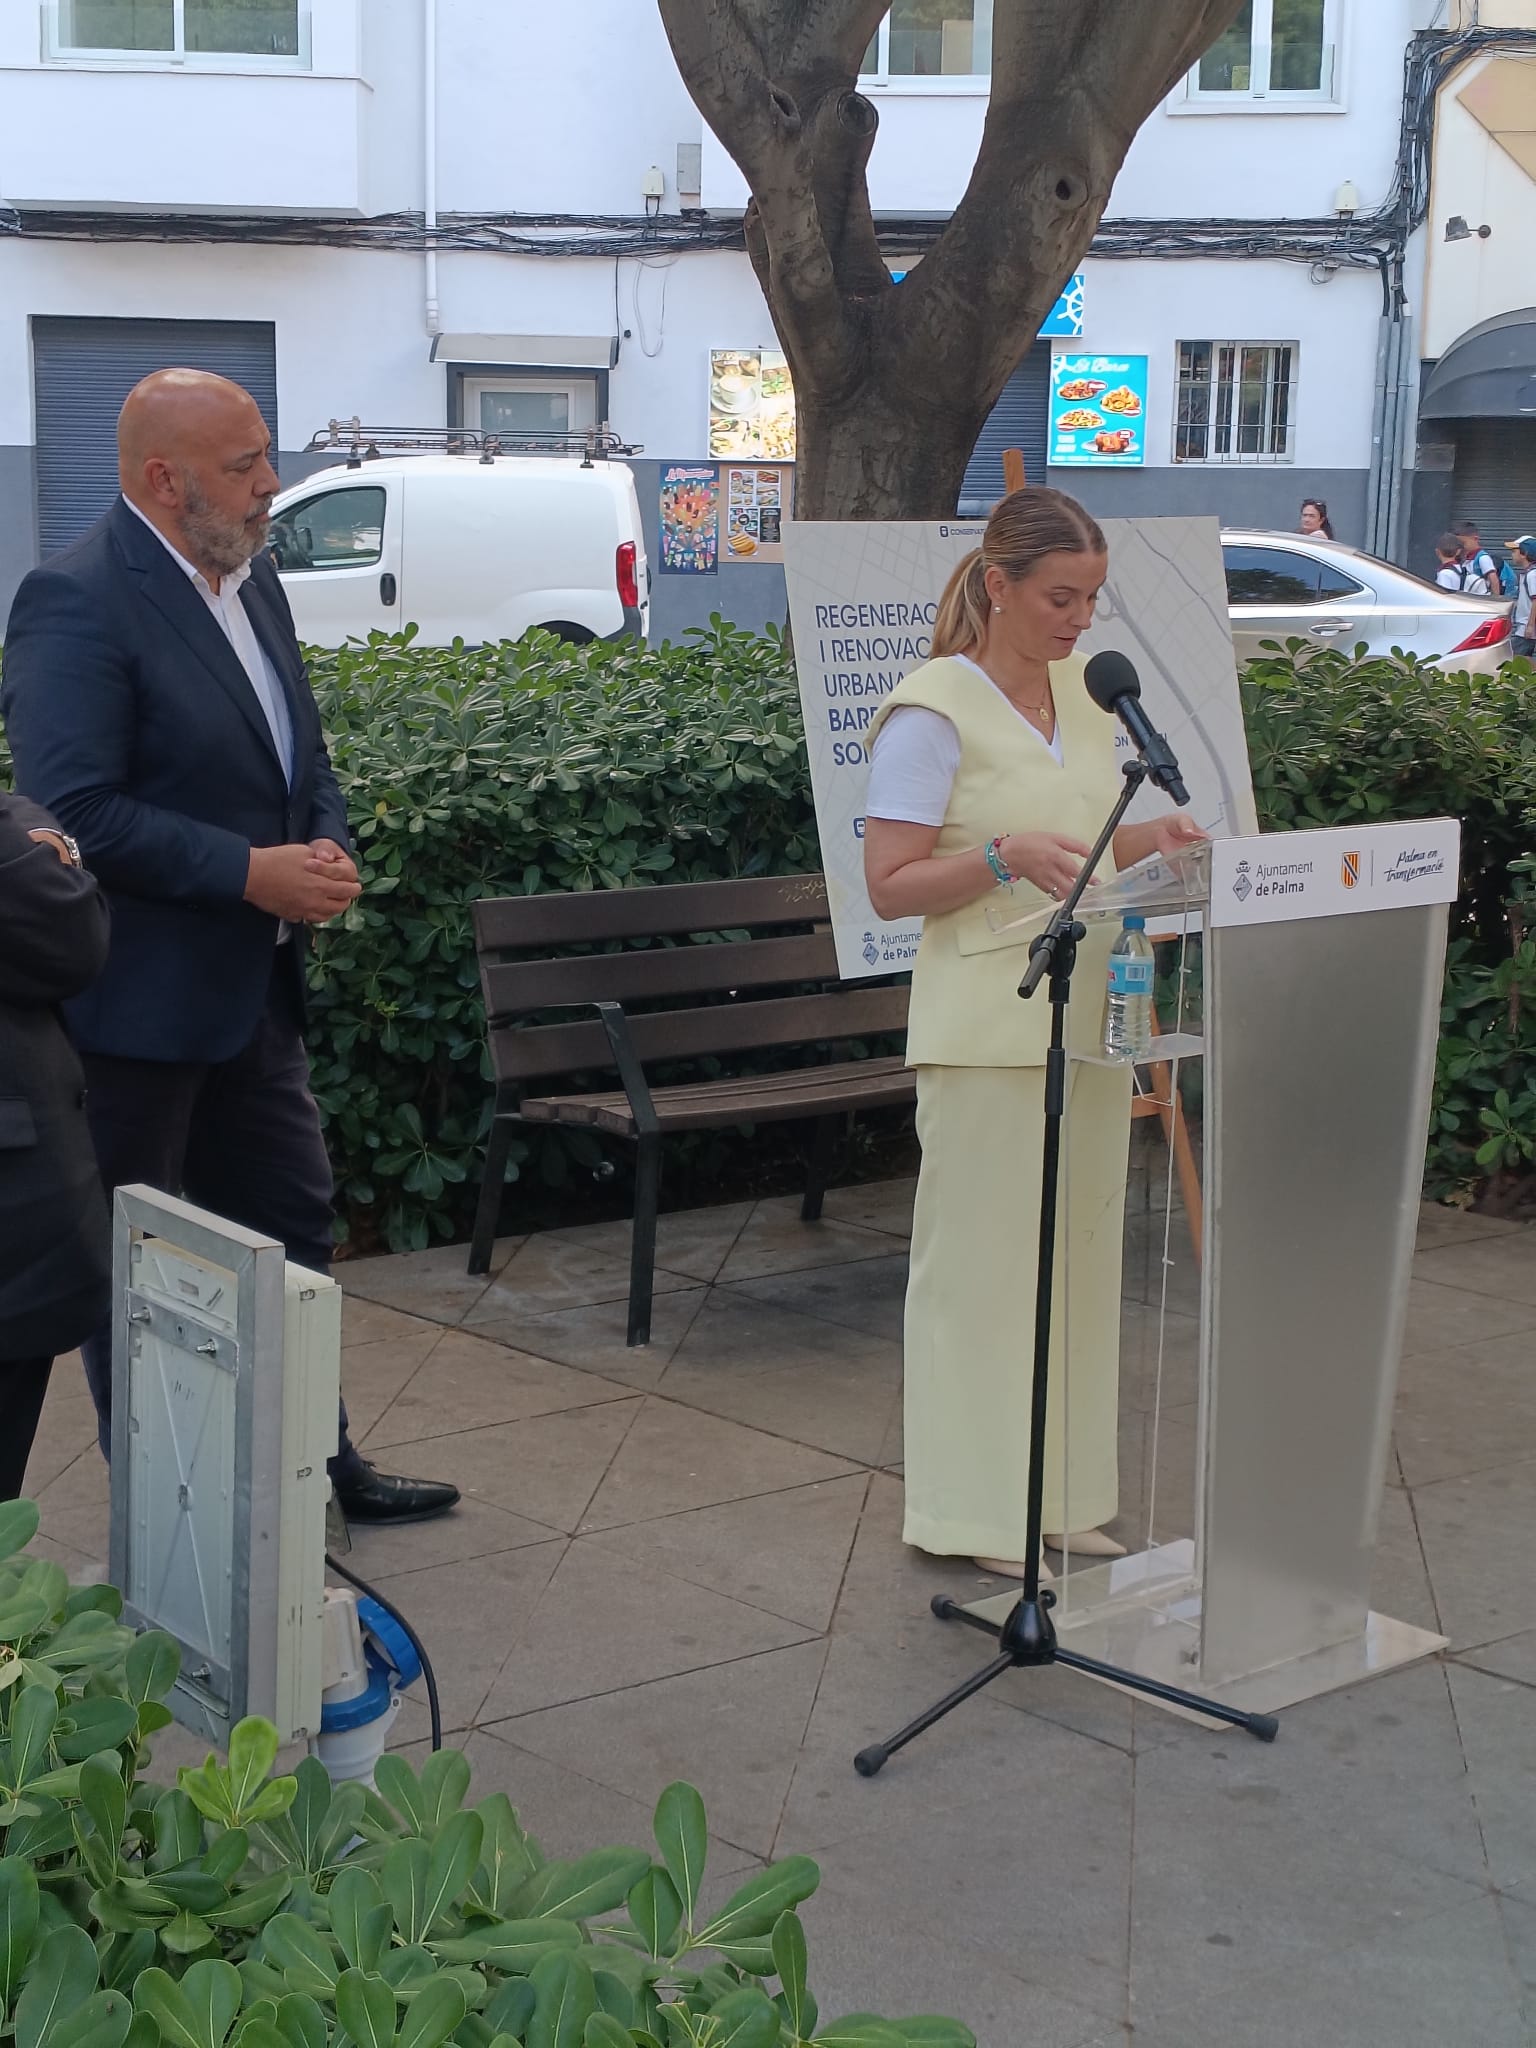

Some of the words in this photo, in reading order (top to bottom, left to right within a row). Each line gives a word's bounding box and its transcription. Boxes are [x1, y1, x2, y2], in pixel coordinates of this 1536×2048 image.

[820, 640, 825, 662] I
[832, 637, 930, 662] RENOVAC
[1396, 848, 1425, 868] Palma
[1427, 850, 1438, 859] en
[1256, 862, 1313, 878] Ajuntament
[1255, 883, 1270, 896] de
[1272, 880, 1305, 895] Palma
[883, 949, 895, 961] de
